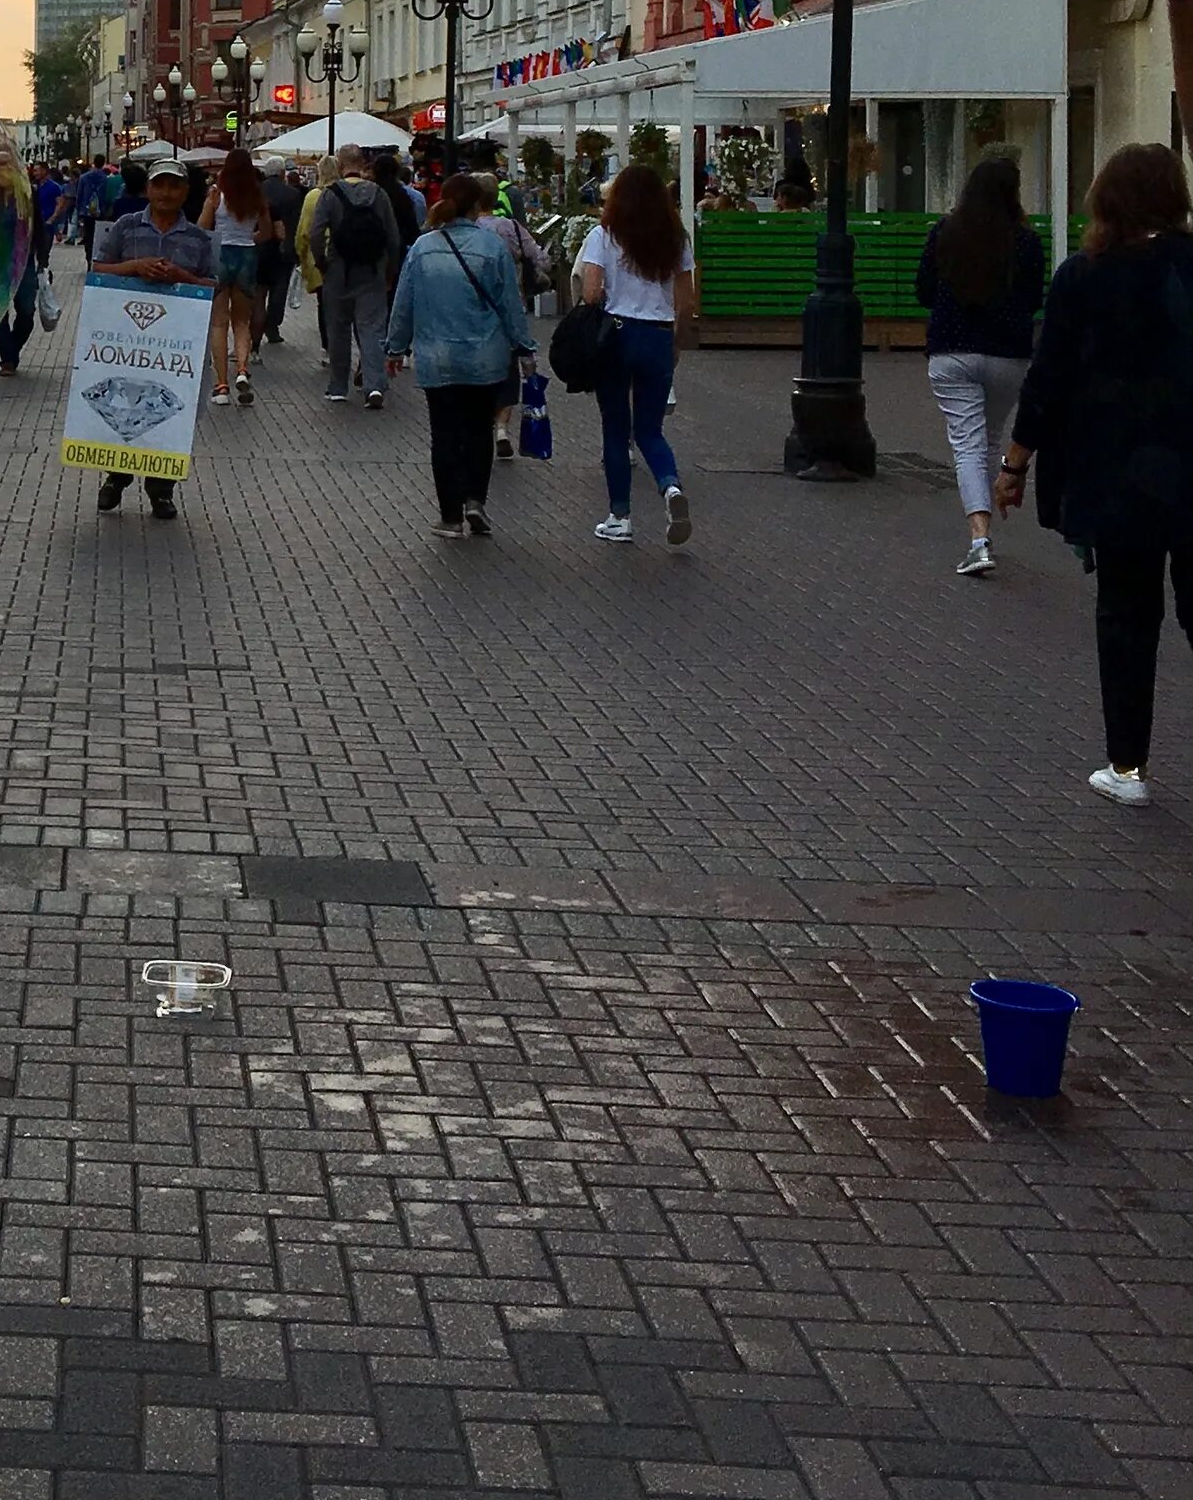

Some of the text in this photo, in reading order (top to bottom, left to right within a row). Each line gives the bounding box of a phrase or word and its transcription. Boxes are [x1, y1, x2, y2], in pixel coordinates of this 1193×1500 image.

[132, 303, 156, 321] 32
[84, 343, 195, 379] ЛОМБАРД
[66, 444, 185, 477] ОБМЕН ВАЛЮТЫ
